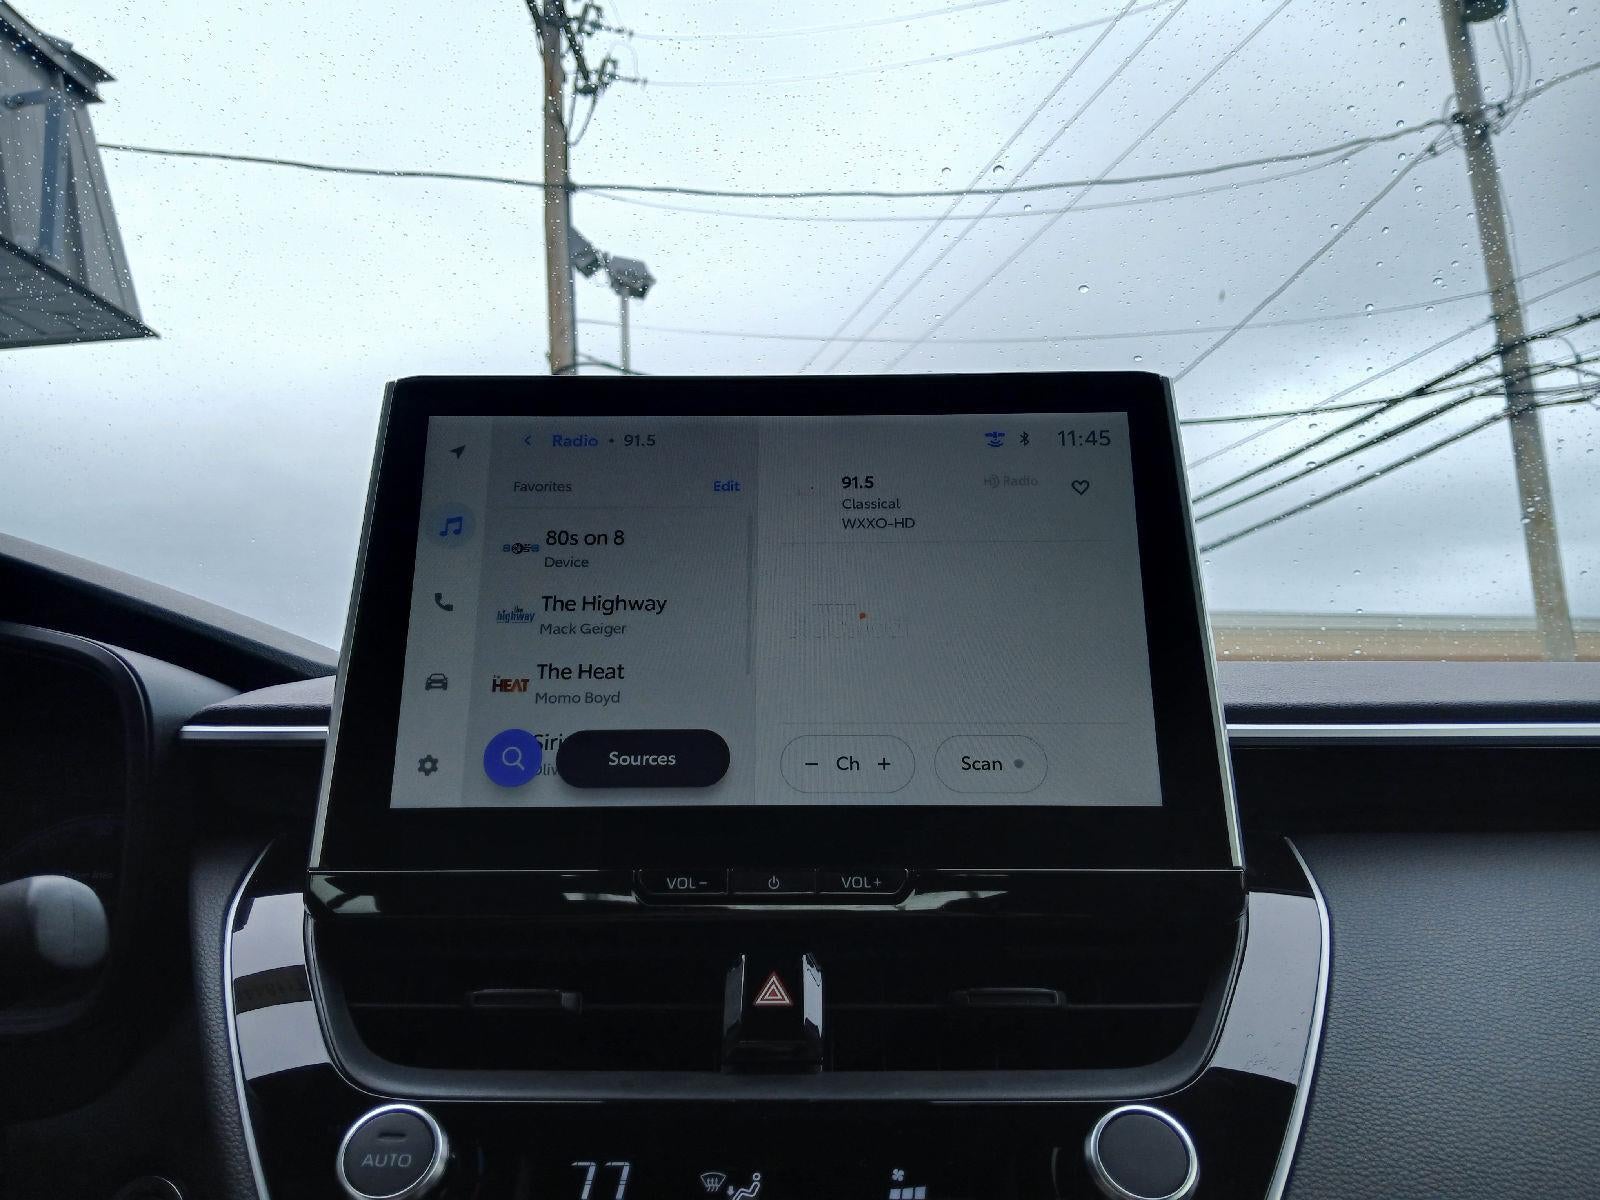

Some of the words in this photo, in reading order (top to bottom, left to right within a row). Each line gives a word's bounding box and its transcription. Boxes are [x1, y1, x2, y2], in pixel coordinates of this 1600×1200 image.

[552, 434, 598, 447] Radio
[624, 435, 656, 447] 91.5
[1057, 429, 1112, 447] 11:45
[513, 481, 572, 493] Favorites
[713, 480, 741, 492] Edit
[841, 476, 874, 489] 91.5
[1003, 475, 1039, 487] Radio
[842, 498, 902, 510] Classical
[841, 517, 916, 529] WXXO-HD
[545, 530, 579, 546] 80s
[584, 533, 608, 546] on
[613, 530, 625, 546] 8
[544, 556, 589, 569] Device
[541, 595, 576, 612] The
[582, 595, 668, 616] Highway
[496, 607, 536, 623] highway
[539, 623, 576, 635] Mack
[580, 623, 626, 638] Geiger
[537, 663, 573, 680] The
[578, 663, 625, 680] Heat
[492, 678, 530, 693] HEAT
[535, 692, 581, 704] Momo
[585, 691, 621, 707] Boyd
[608, 751, 677, 766] Sources
[836, 756, 860, 771] Ch
[960, 756, 1003, 771] Scan
[361, 1153, 412, 1168] AUTO
[571, 1161, 631, 1200] 77
